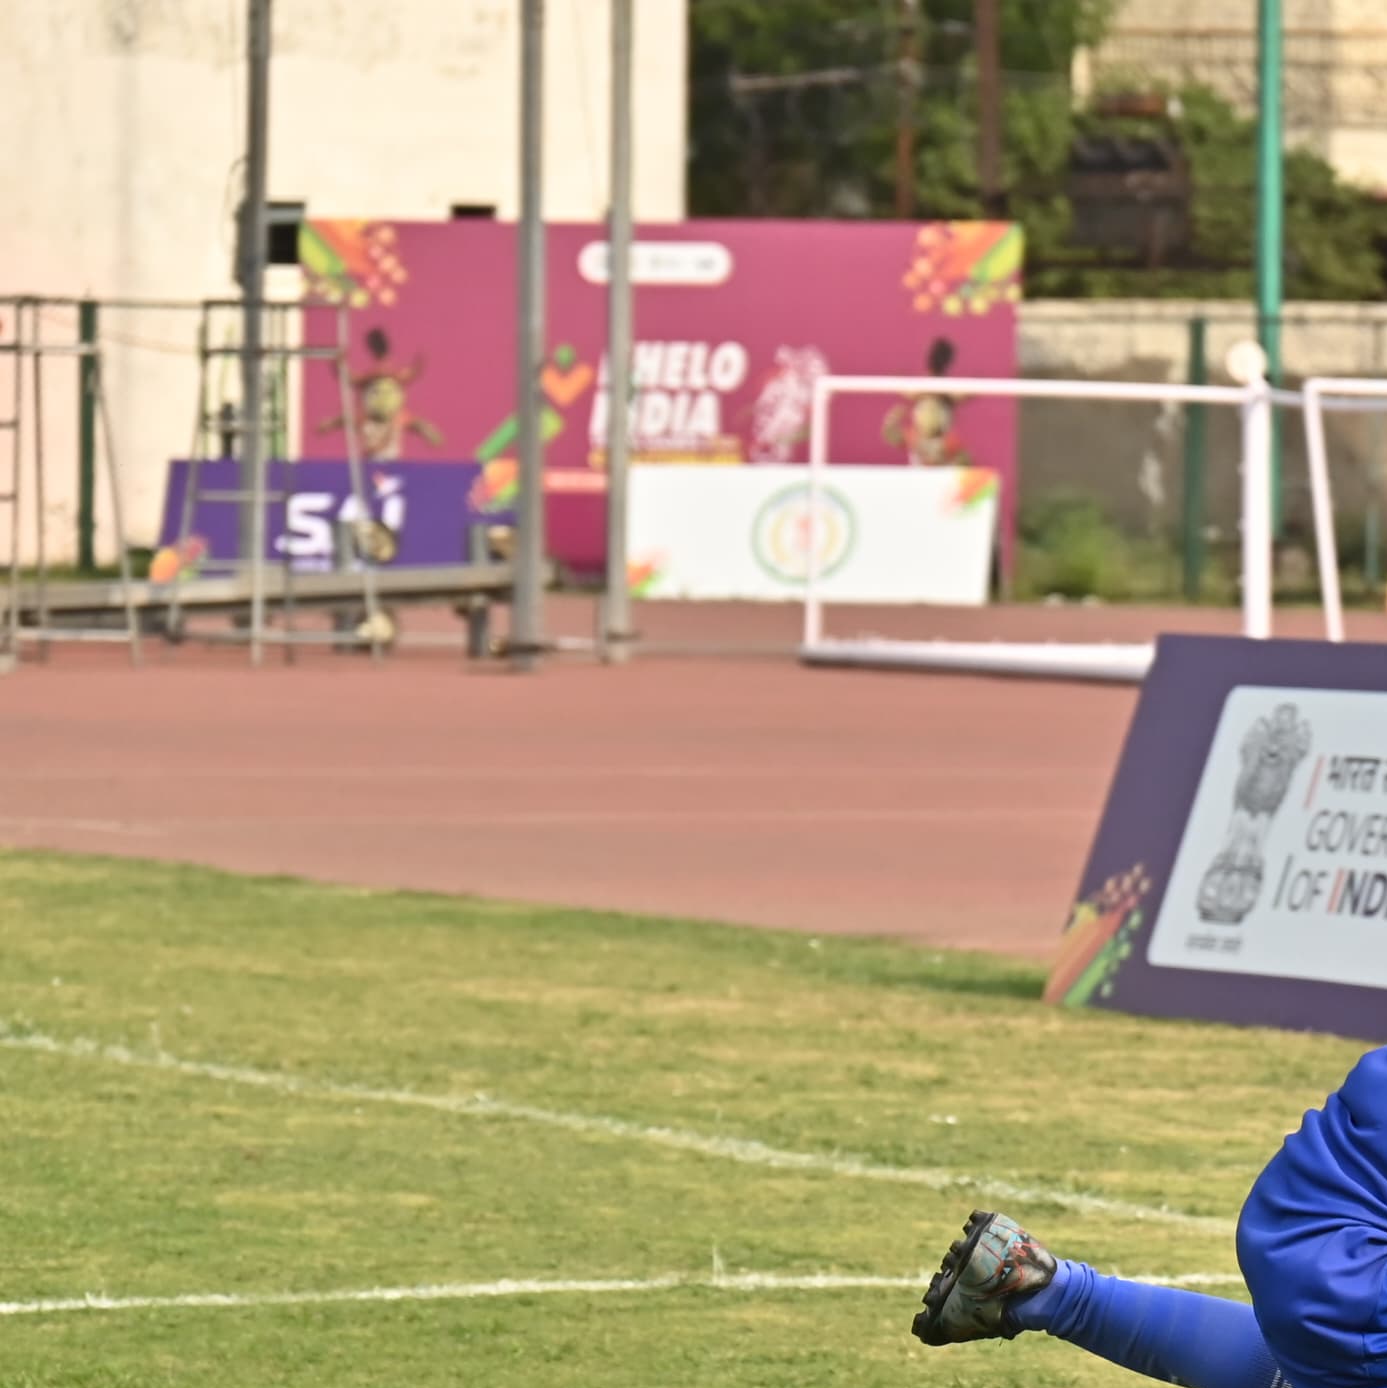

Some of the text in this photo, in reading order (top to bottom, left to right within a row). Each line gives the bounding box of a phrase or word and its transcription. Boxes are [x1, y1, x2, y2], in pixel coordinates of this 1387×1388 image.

[597, 340, 749, 394] HELO
[589, 388, 723, 440] IDIA
[1328, 756, 1381, 792] भारत
[1288, 868, 1329, 914] OF
